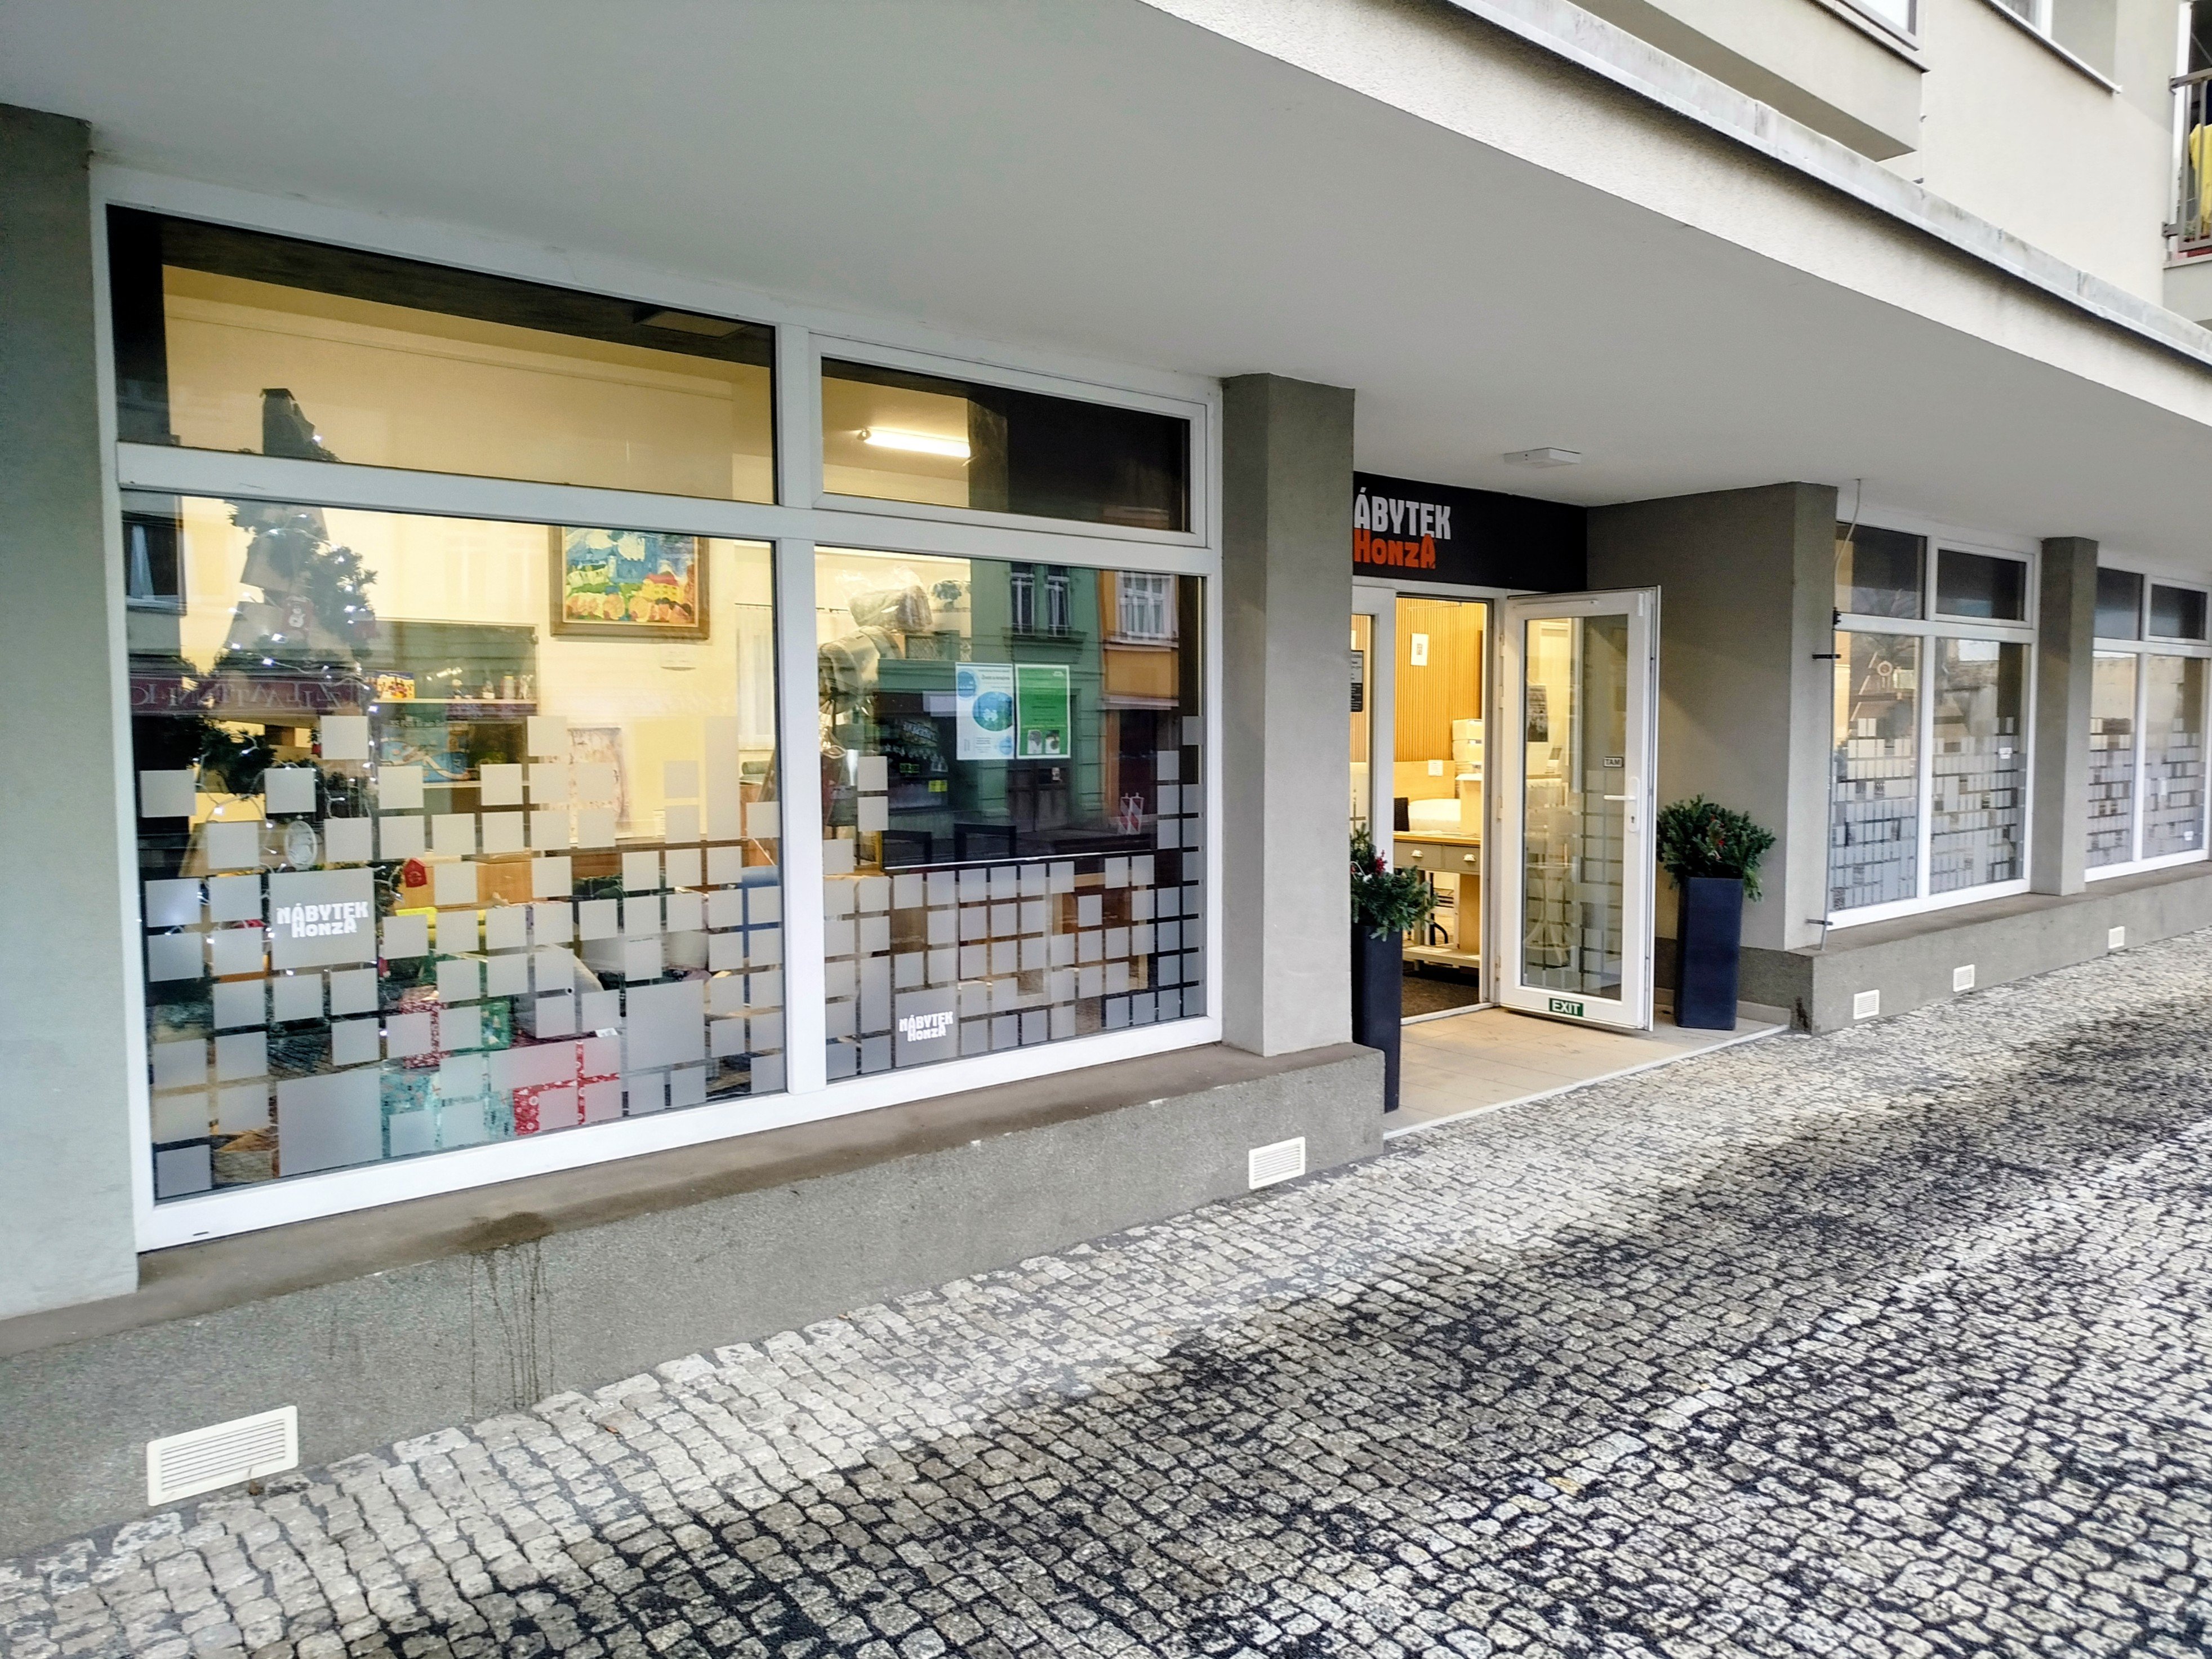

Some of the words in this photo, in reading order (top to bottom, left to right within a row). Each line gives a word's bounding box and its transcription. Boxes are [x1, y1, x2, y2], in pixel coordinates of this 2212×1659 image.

[1354, 487, 1451, 540] ÁBYTEK
[276, 902, 369, 924] NÁBYTEK
[1552, 999, 1581, 1015] EXIT
[899, 1011, 953, 1032] NÁBYTEK
